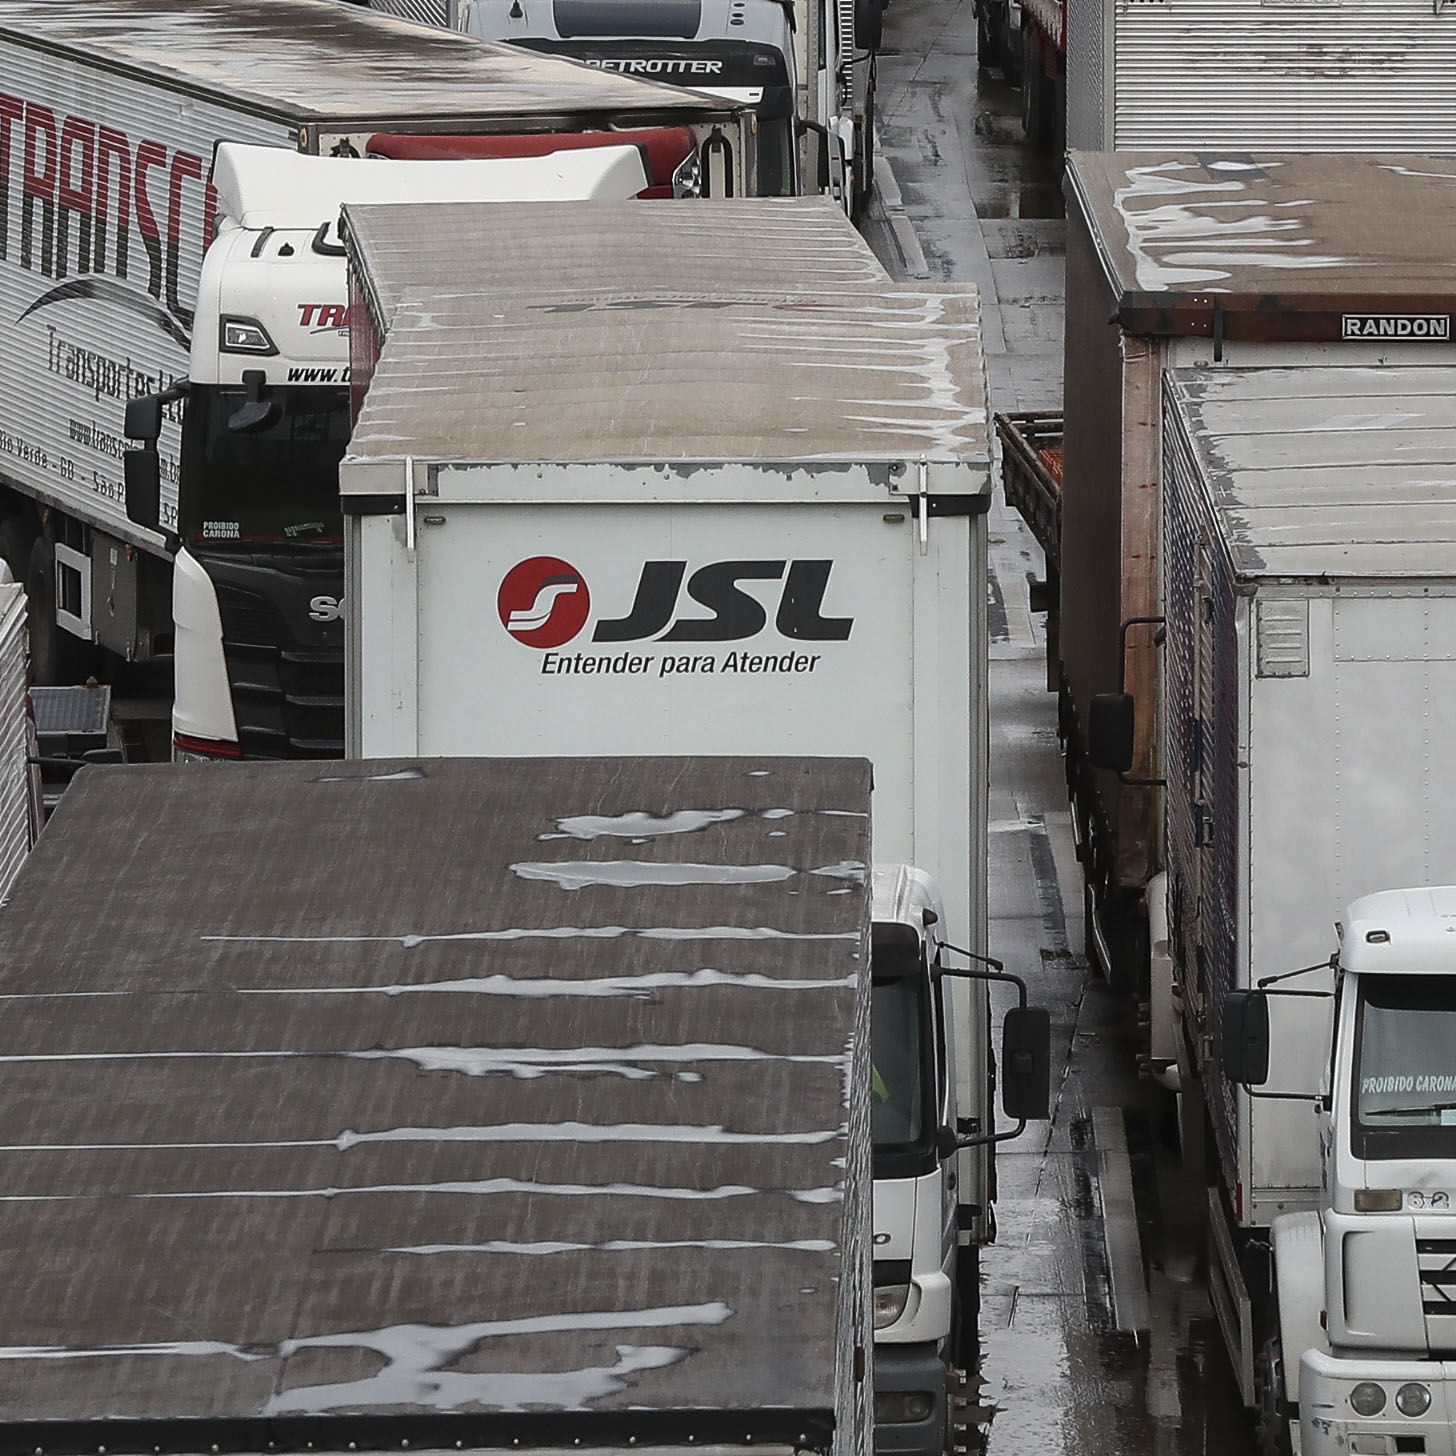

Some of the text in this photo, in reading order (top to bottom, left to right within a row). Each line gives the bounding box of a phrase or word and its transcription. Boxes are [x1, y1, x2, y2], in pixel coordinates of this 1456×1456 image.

[1345, 318, 1447, 336] RANDON
[16, 436, 48, 469] Verde
[203, 522, 240, 530] PROIBIDO
[203, 530, 240, 538] CARONA
[592, 560, 855, 643] JSL
[541, 651, 822, 678] Entender para Atender
[1361, 1076, 1414, 1094] PROIBIDO
